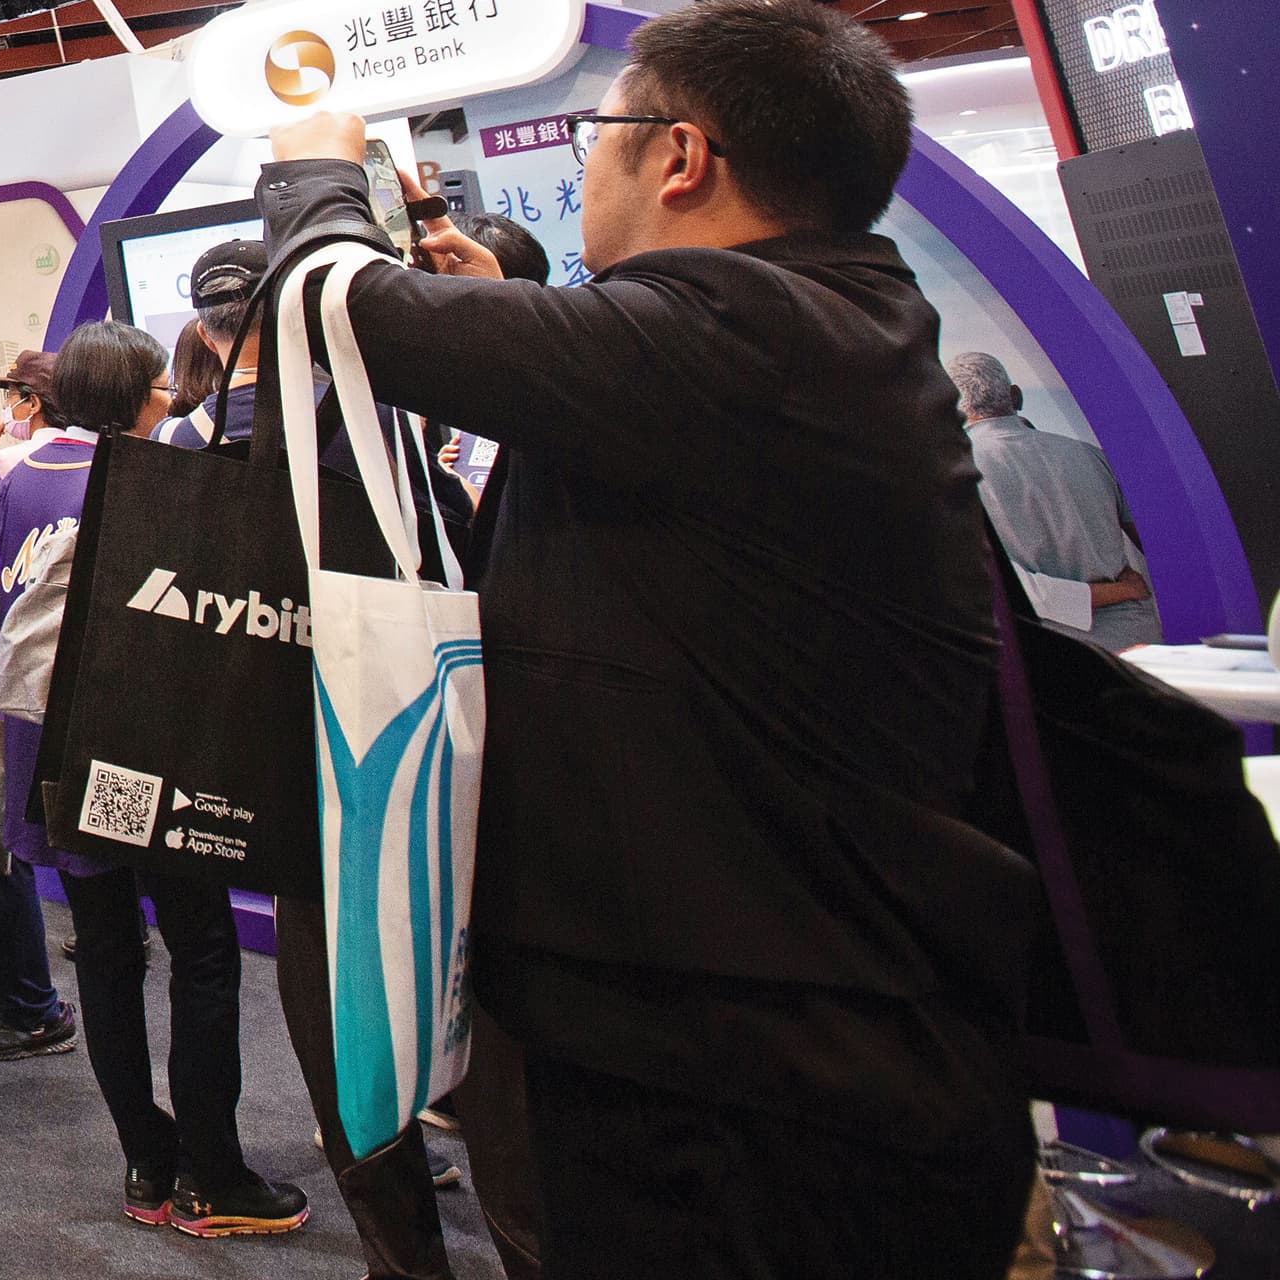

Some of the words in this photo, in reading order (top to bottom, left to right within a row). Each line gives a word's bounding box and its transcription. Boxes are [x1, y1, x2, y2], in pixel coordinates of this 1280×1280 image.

[352, 55, 407, 80] Mega
[414, 38, 467, 66] Bank
[195, 589, 313, 647] rybit
[194, 798, 232, 819] Google
[233, 806, 255, 824] play
[186, 837, 213, 856] App
[213, 842, 246, 861] Store
[188, 828, 224, 843] Download
[224, 836, 234, 845] on
[234, 838, 247, 848] the
